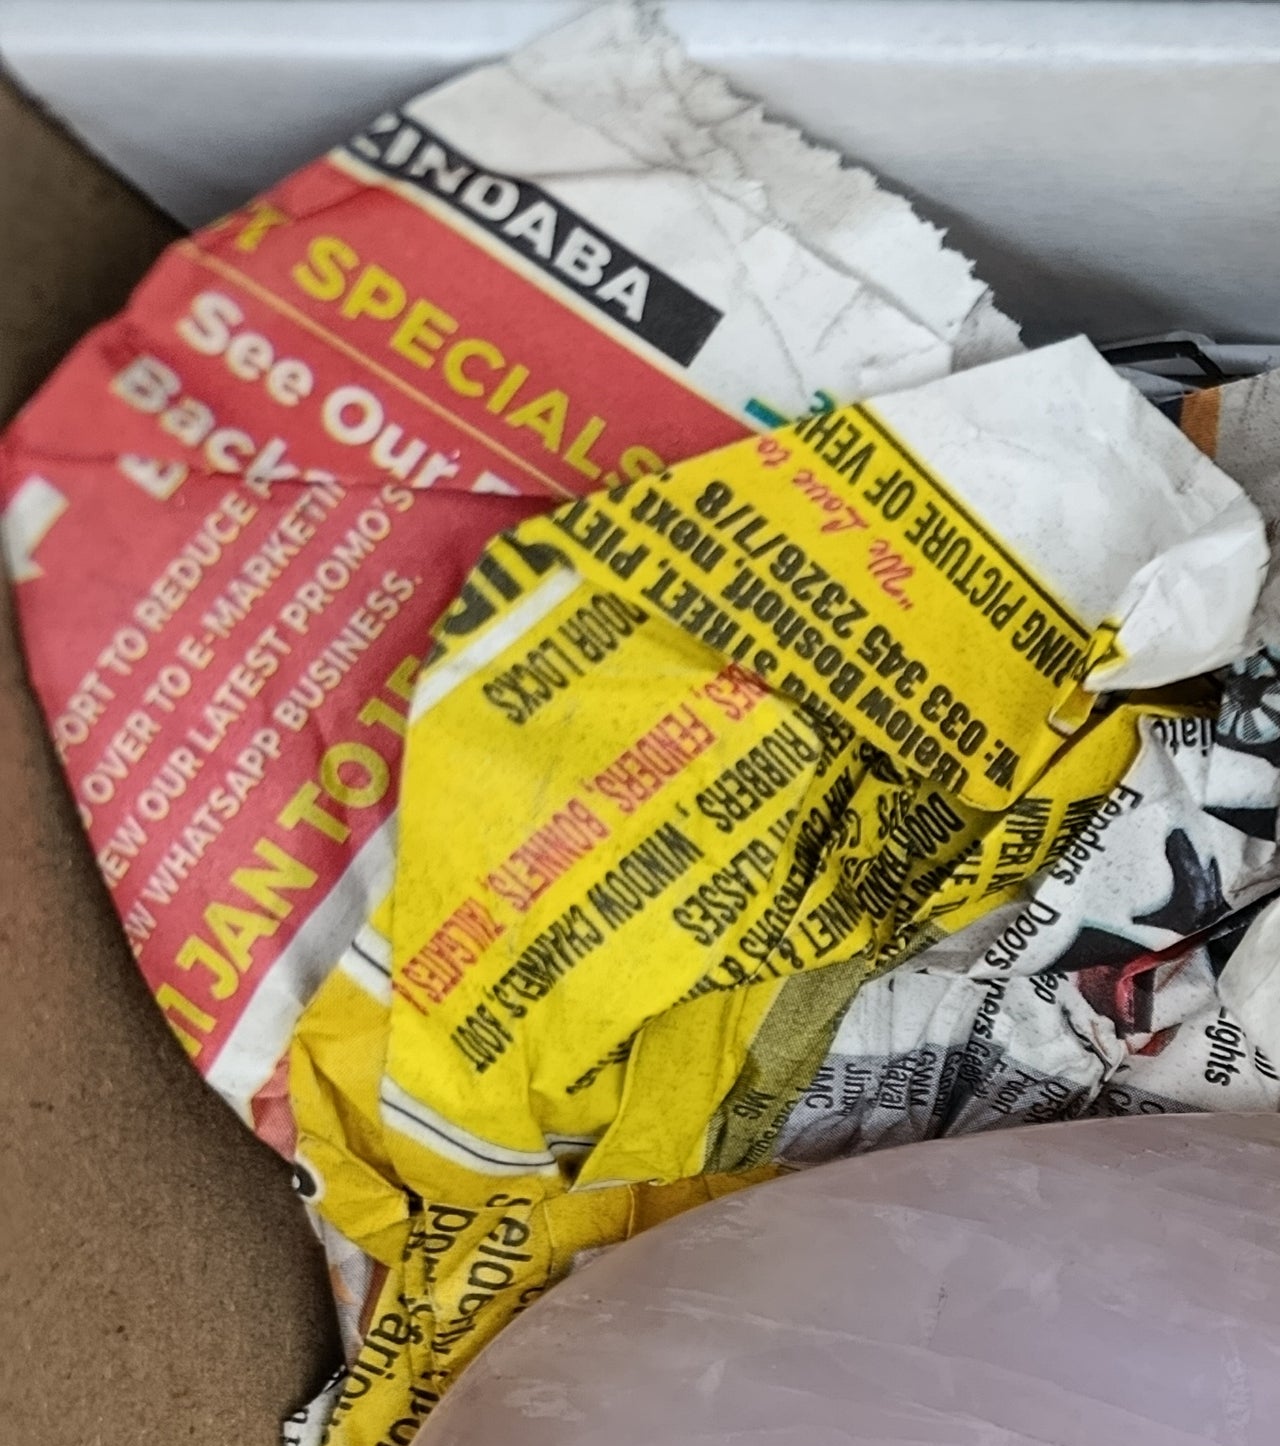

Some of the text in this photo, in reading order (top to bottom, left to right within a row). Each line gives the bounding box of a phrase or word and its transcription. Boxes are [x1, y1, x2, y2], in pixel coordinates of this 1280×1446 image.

[176, 290, 314, 407] See
[321, 385, 460, 490] Our
[862, 468, 918, 523] OF
[97, 625, 151, 678] TO
[132, 490, 259, 636] REDUCE
[694, 480, 871, 641] 2326/7/8
[903, 500, 1031, 633] PICTURE
[136, 483, 414, 823] OUR LATEST PROMO'S
[481, 638, 588, 726] LOCKS
[857, 624, 930, 701] 345
[81, 663, 193, 805] OVER TO
[142, 568, 424, 906] WHATSAPP BUSINESS.
[582, 702, 717, 815] FENDERS,
[917, 683, 989, 753] 033
[694, 719, 822, 834] RUBBERS
[175, 836, 320, 1002] JAN
[276, 740, 392, 845] TO
[480, 796, 611, 914] BONNETS,
[587, 821, 706, 932] WINDOW
[672, 839, 776, 948] GLASSES
[983, 897, 1065, 977] Doors
